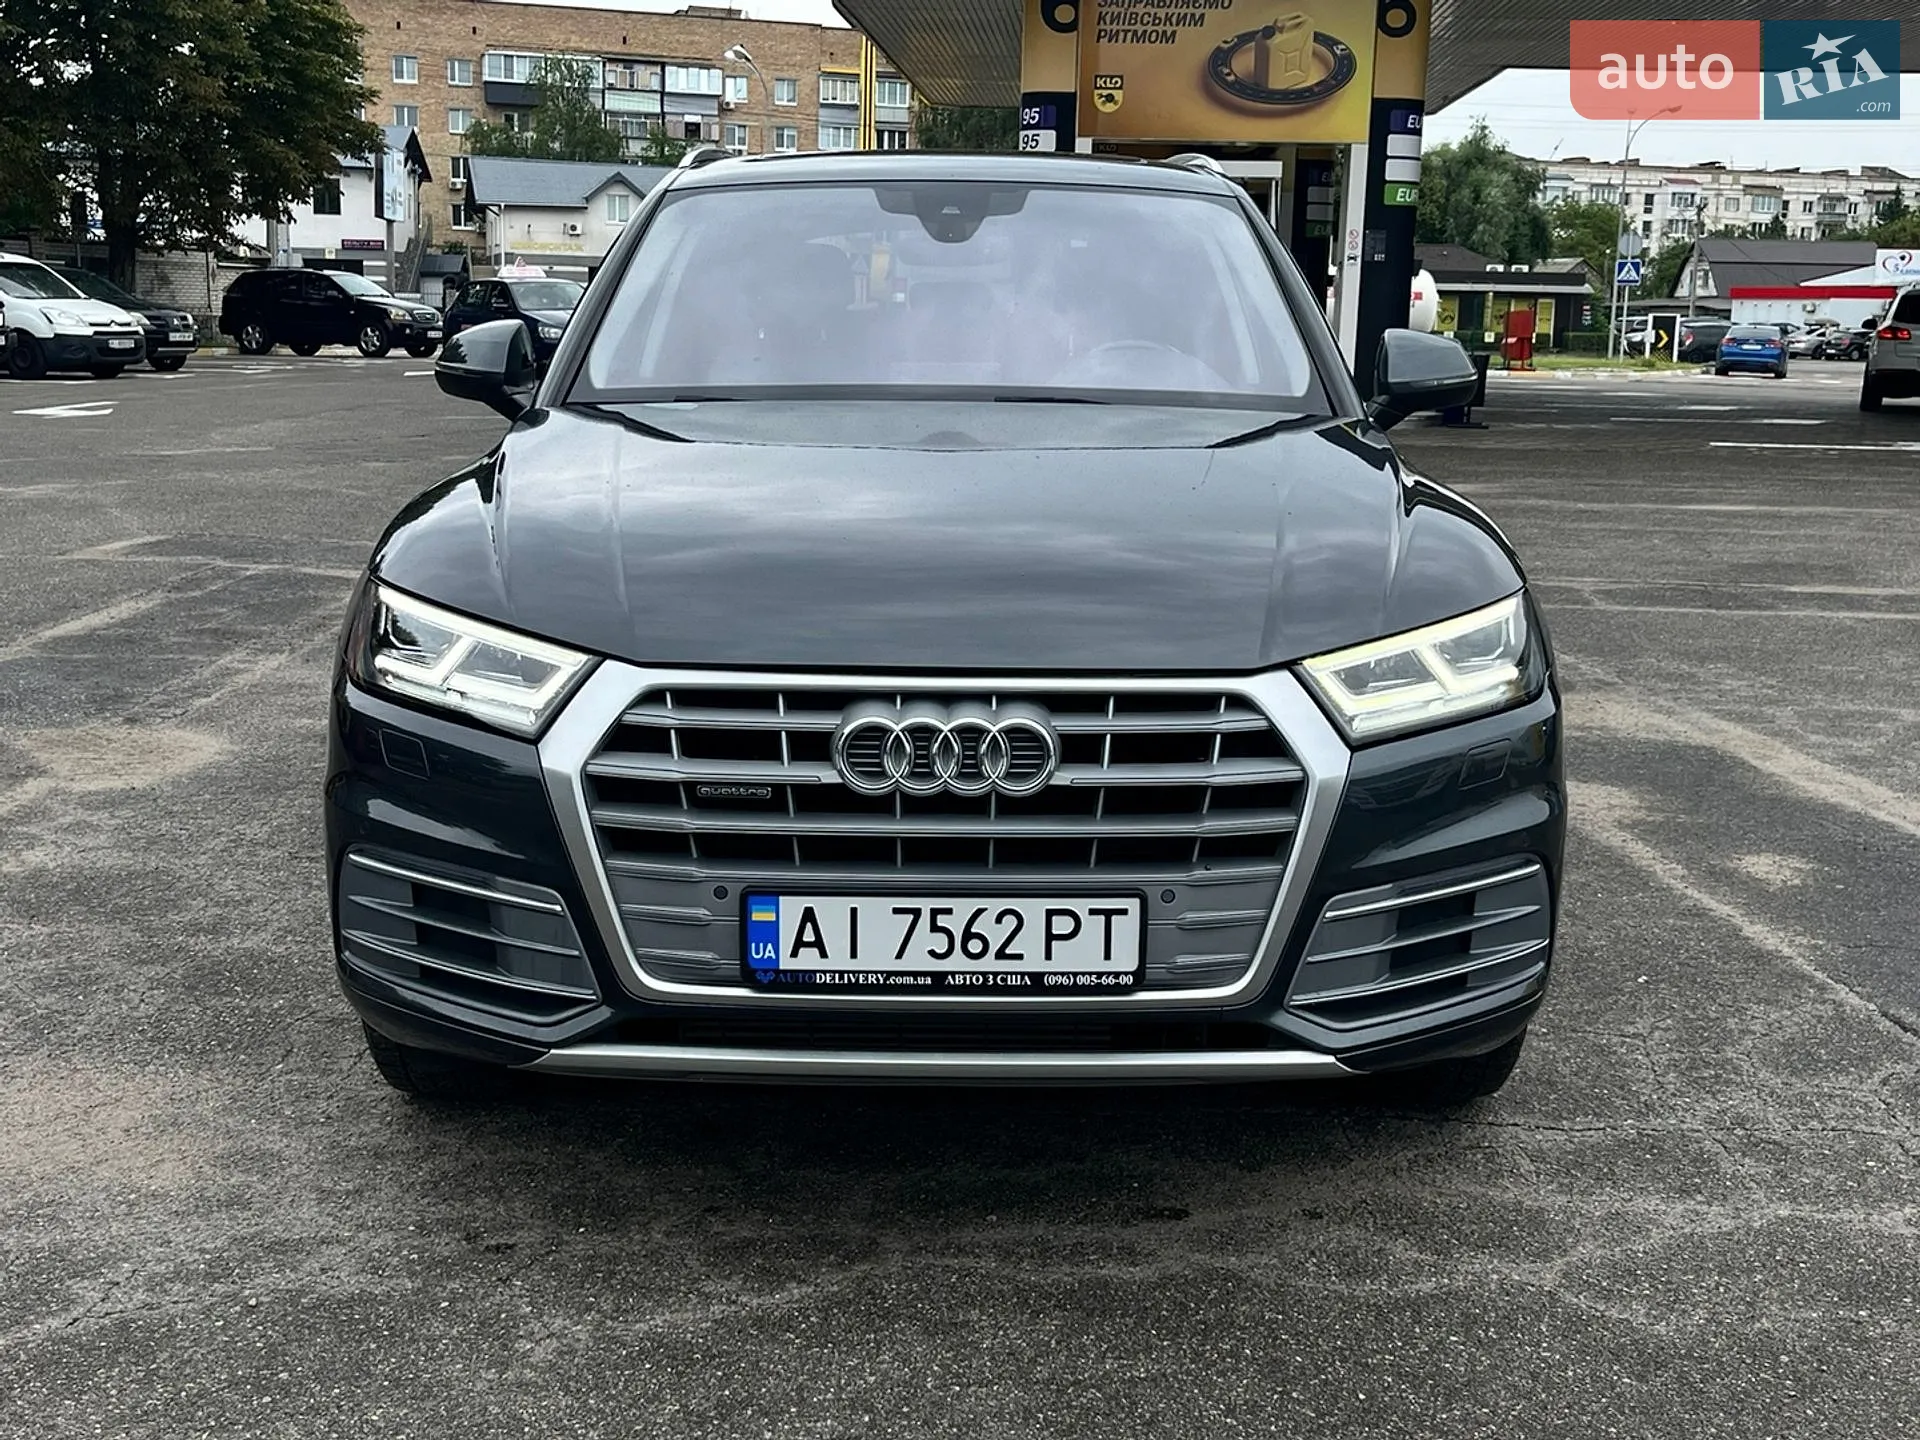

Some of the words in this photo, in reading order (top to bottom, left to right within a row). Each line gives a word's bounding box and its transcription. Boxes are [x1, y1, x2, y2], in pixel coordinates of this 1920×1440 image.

[1096, 9, 1205, 27] КИЇВСЬКИМ
[1096, 29, 1177, 44] РИТМОМ
[1096, 77, 1122, 88] KLO
[1022, 107, 1040, 125] 95
[1022, 133, 1040, 150] 95
[700, 787, 768, 797] quattro
[892, 907, 1025, 960] 7562
[1044, 908, 1129, 961] PT
[751, 942, 776, 960] UA
[945, 974, 983, 986] АВТО
[997, 974, 1031, 986] США
[1044, 974, 1073, 987] (096)
[1076, 974, 1134, 986] 005-66-00
